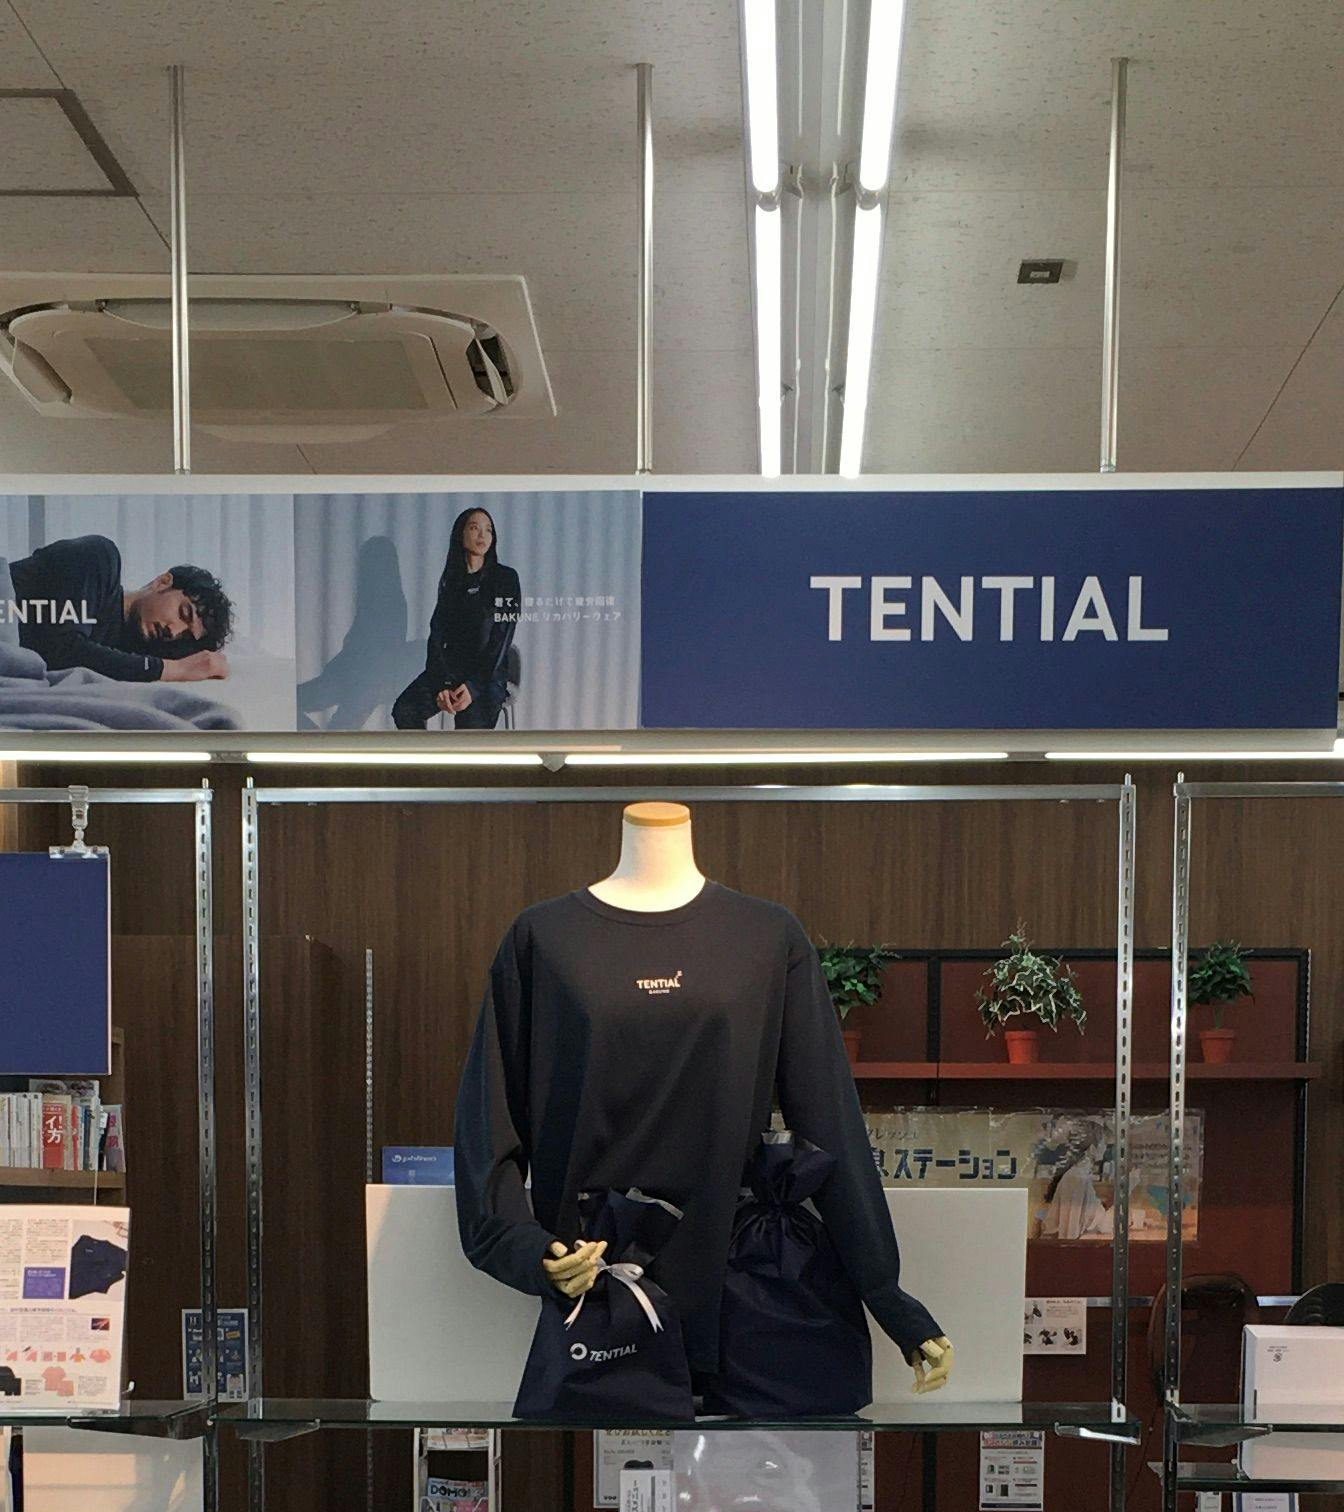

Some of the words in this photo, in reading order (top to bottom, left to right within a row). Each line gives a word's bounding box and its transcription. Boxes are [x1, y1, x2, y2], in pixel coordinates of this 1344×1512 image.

[810, 575, 1169, 641] TENTIAL
[494, 612, 539, 623] BAKUNE
[636, 977, 681, 989] TENTIAL
[589, 1343, 638, 1361] TENTIAL
